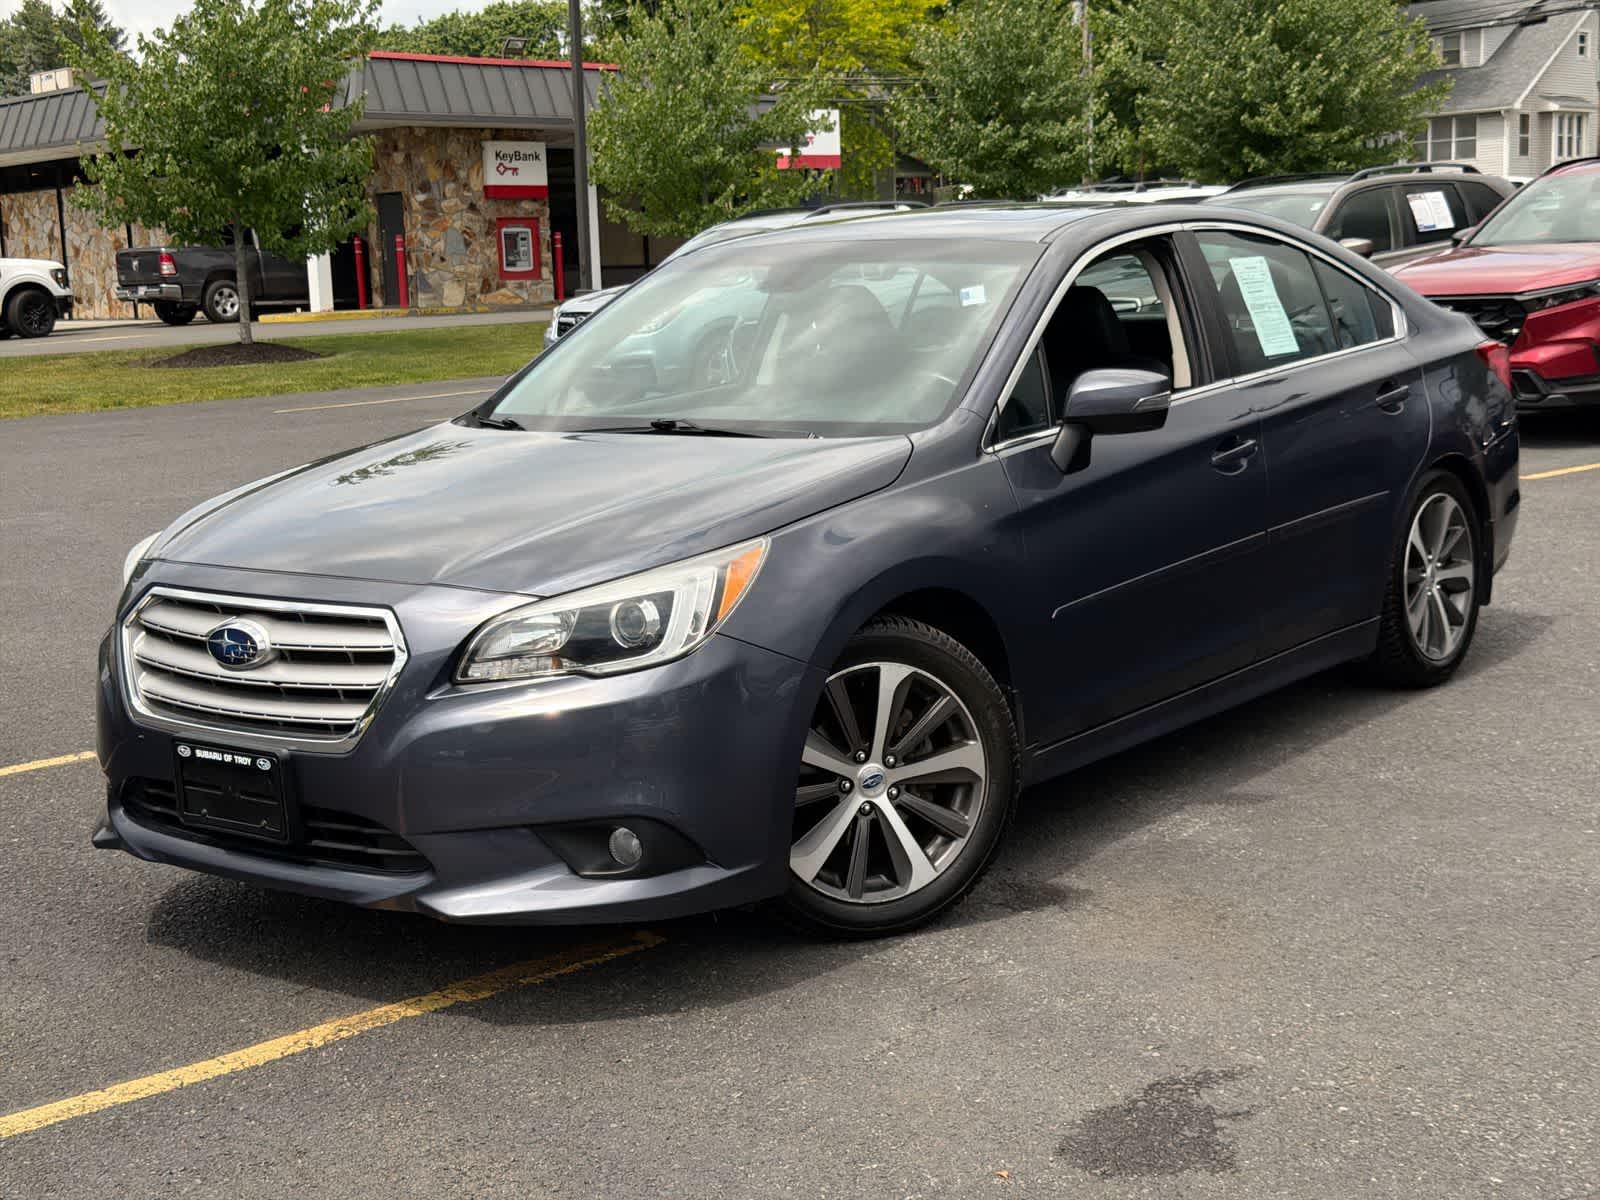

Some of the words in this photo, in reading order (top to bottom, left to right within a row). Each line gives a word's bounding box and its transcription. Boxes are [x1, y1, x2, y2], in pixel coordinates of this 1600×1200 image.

[495, 150, 541, 163] KeyBank
[195, 749, 222, 761] SUBARU
[223, 754, 233, 763] OF
[234, 755, 252, 766] TROY
